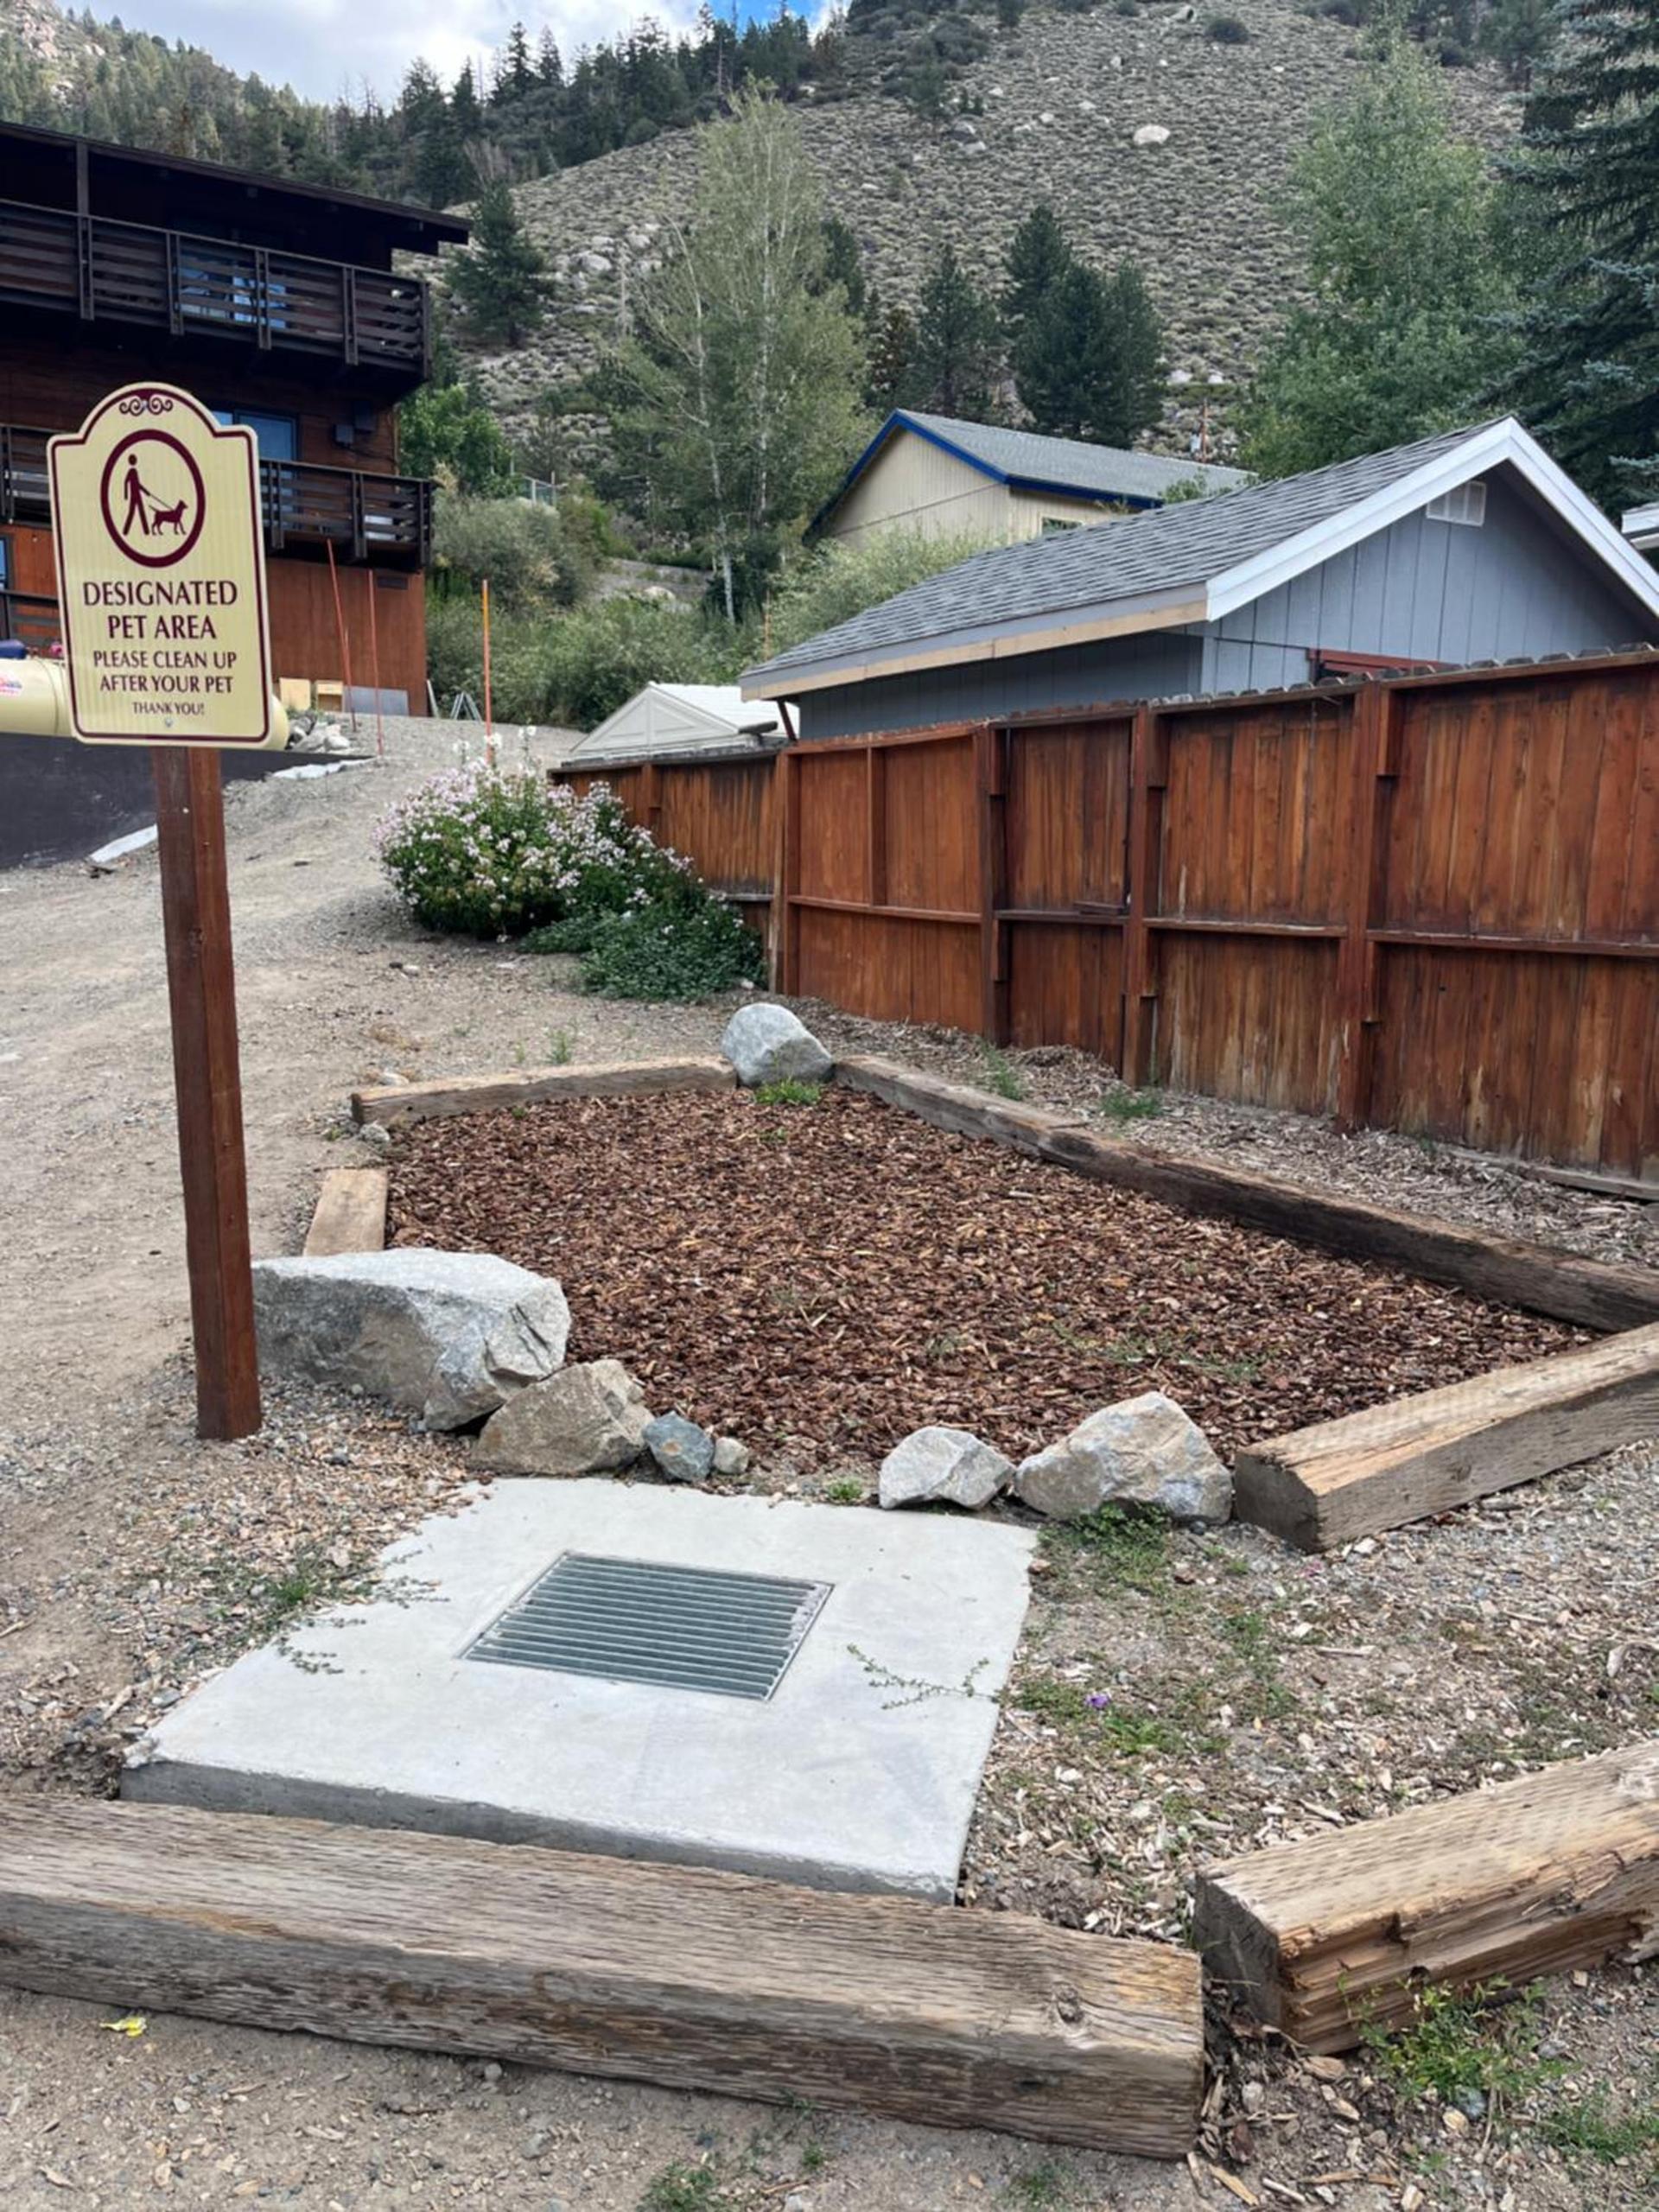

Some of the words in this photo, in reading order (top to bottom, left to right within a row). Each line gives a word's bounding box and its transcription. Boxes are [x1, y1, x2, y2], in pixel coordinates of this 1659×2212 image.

[83, 580, 238, 606] DESIGNATED
[108, 614, 147, 639] PET
[154, 615, 216, 639] AREA
[93, 650, 148, 668] PLEASE
[153, 651, 207, 668] CLEAN
[213, 652, 237, 669] UP
[99, 674, 148, 692] AFTER
[151, 675, 200, 693] YOUR
[206, 676, 233, 693] PET
[132, 702, 173, 715] THANK
[174, 702, 204, 715] YOU!
